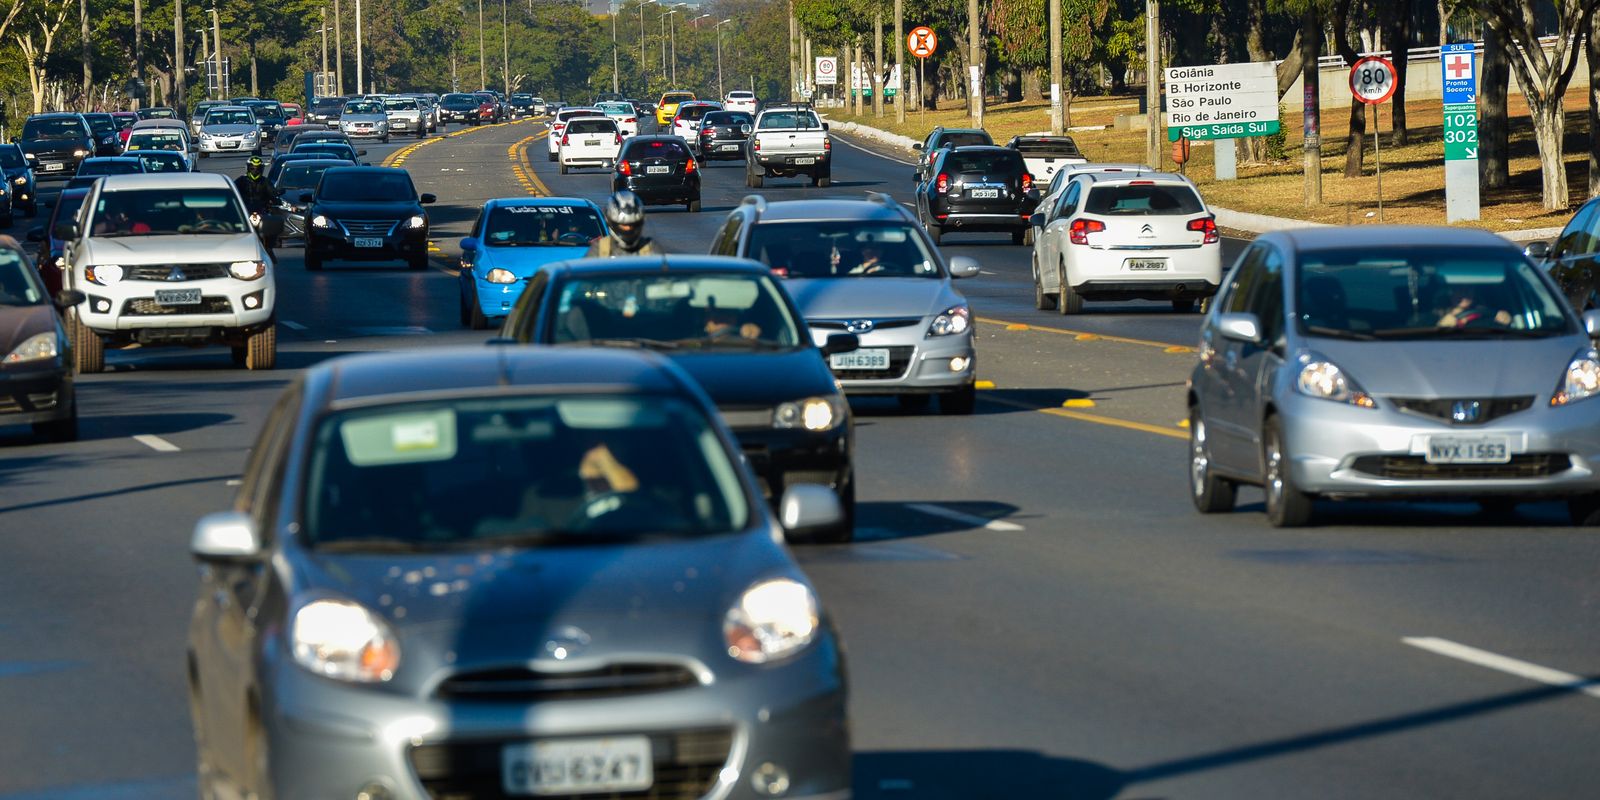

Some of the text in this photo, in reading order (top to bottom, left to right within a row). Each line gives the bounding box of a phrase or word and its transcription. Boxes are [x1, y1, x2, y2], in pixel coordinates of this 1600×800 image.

[1170, 68, 1214, 79] Goiânia
[1362, 68, 1385, 85] 80
[1171, 81, 1242, 94] B. Horizonte
[1172, 96, 1232, 108] São Paulo
[1172, 110, 1257, 123] Rio de Janeiro
[1445, 114, 1476, 127] 102
[1182, 122, 1267, 139] Siga Saída Sul
[1445, 130, 1477, 144] 302
[504, 206, 538, 214] Tudo
